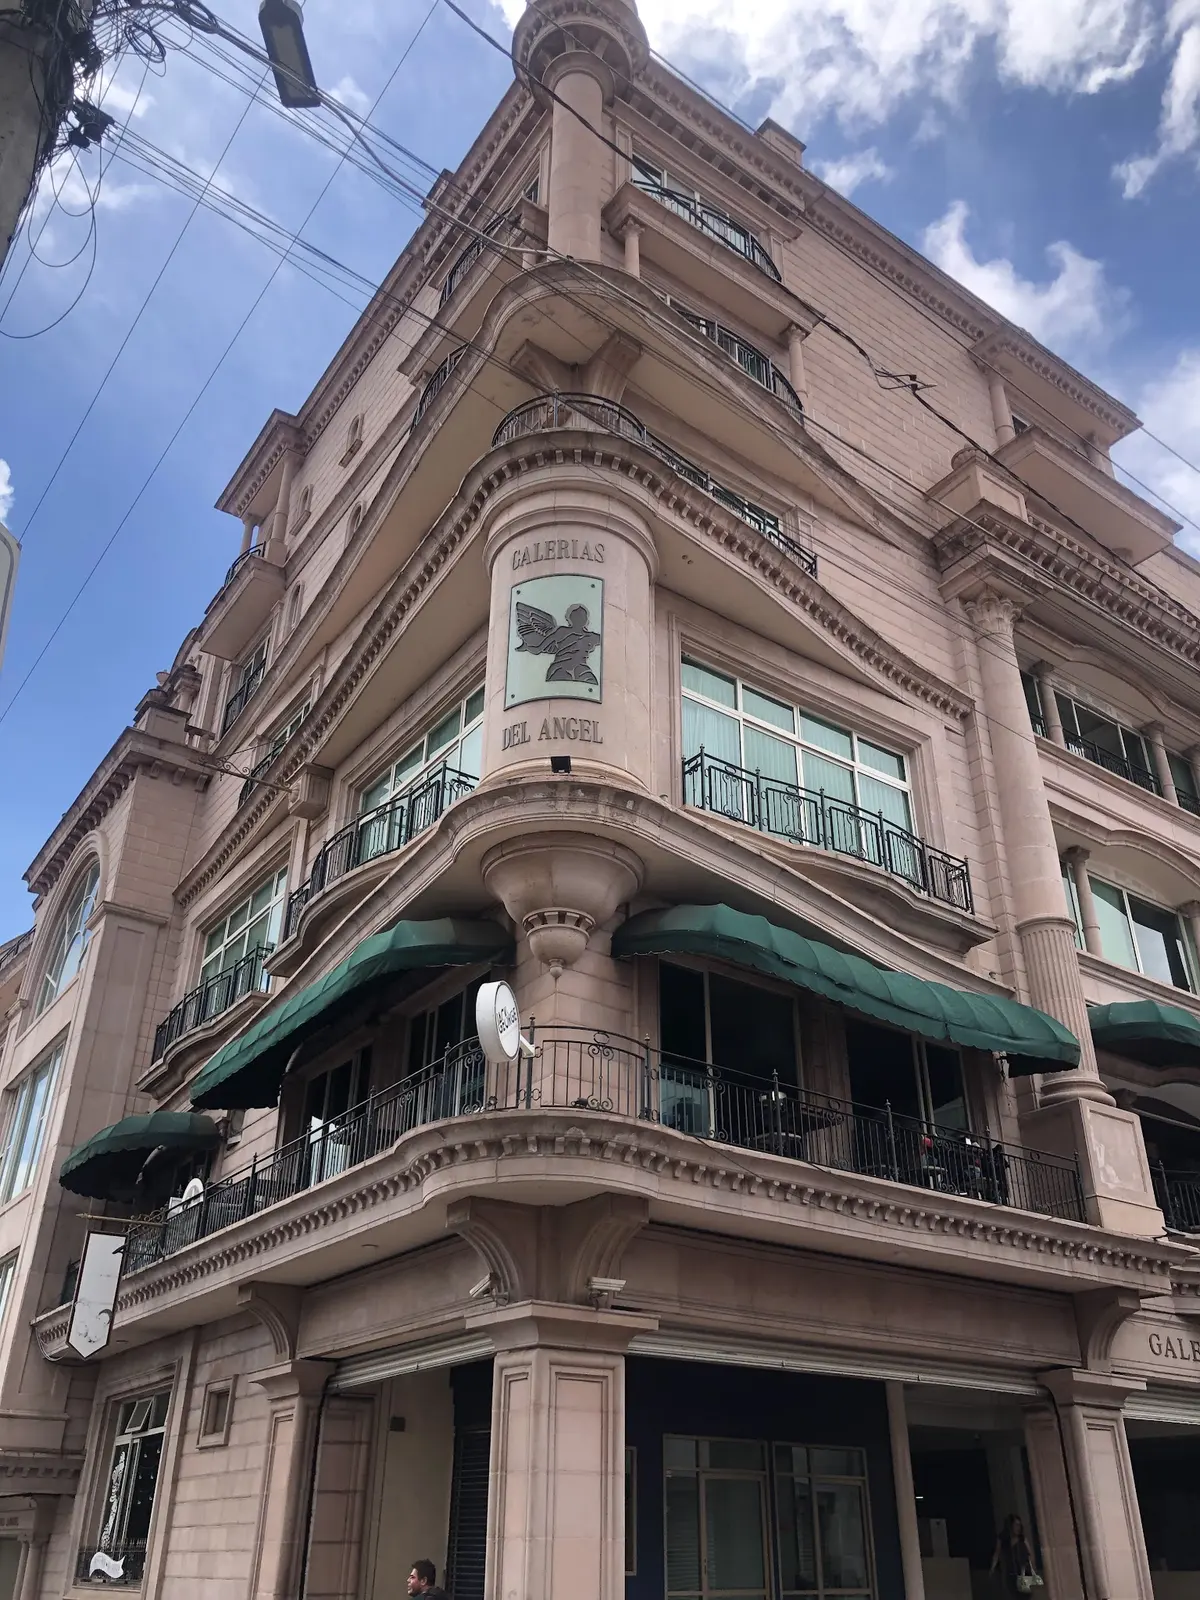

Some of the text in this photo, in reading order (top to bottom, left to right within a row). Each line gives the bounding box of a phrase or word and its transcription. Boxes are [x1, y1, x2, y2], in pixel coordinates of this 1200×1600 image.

[512, 538, 605, 571] GALERIAS
[501, 716, 604, 751] DEL ANGEL
